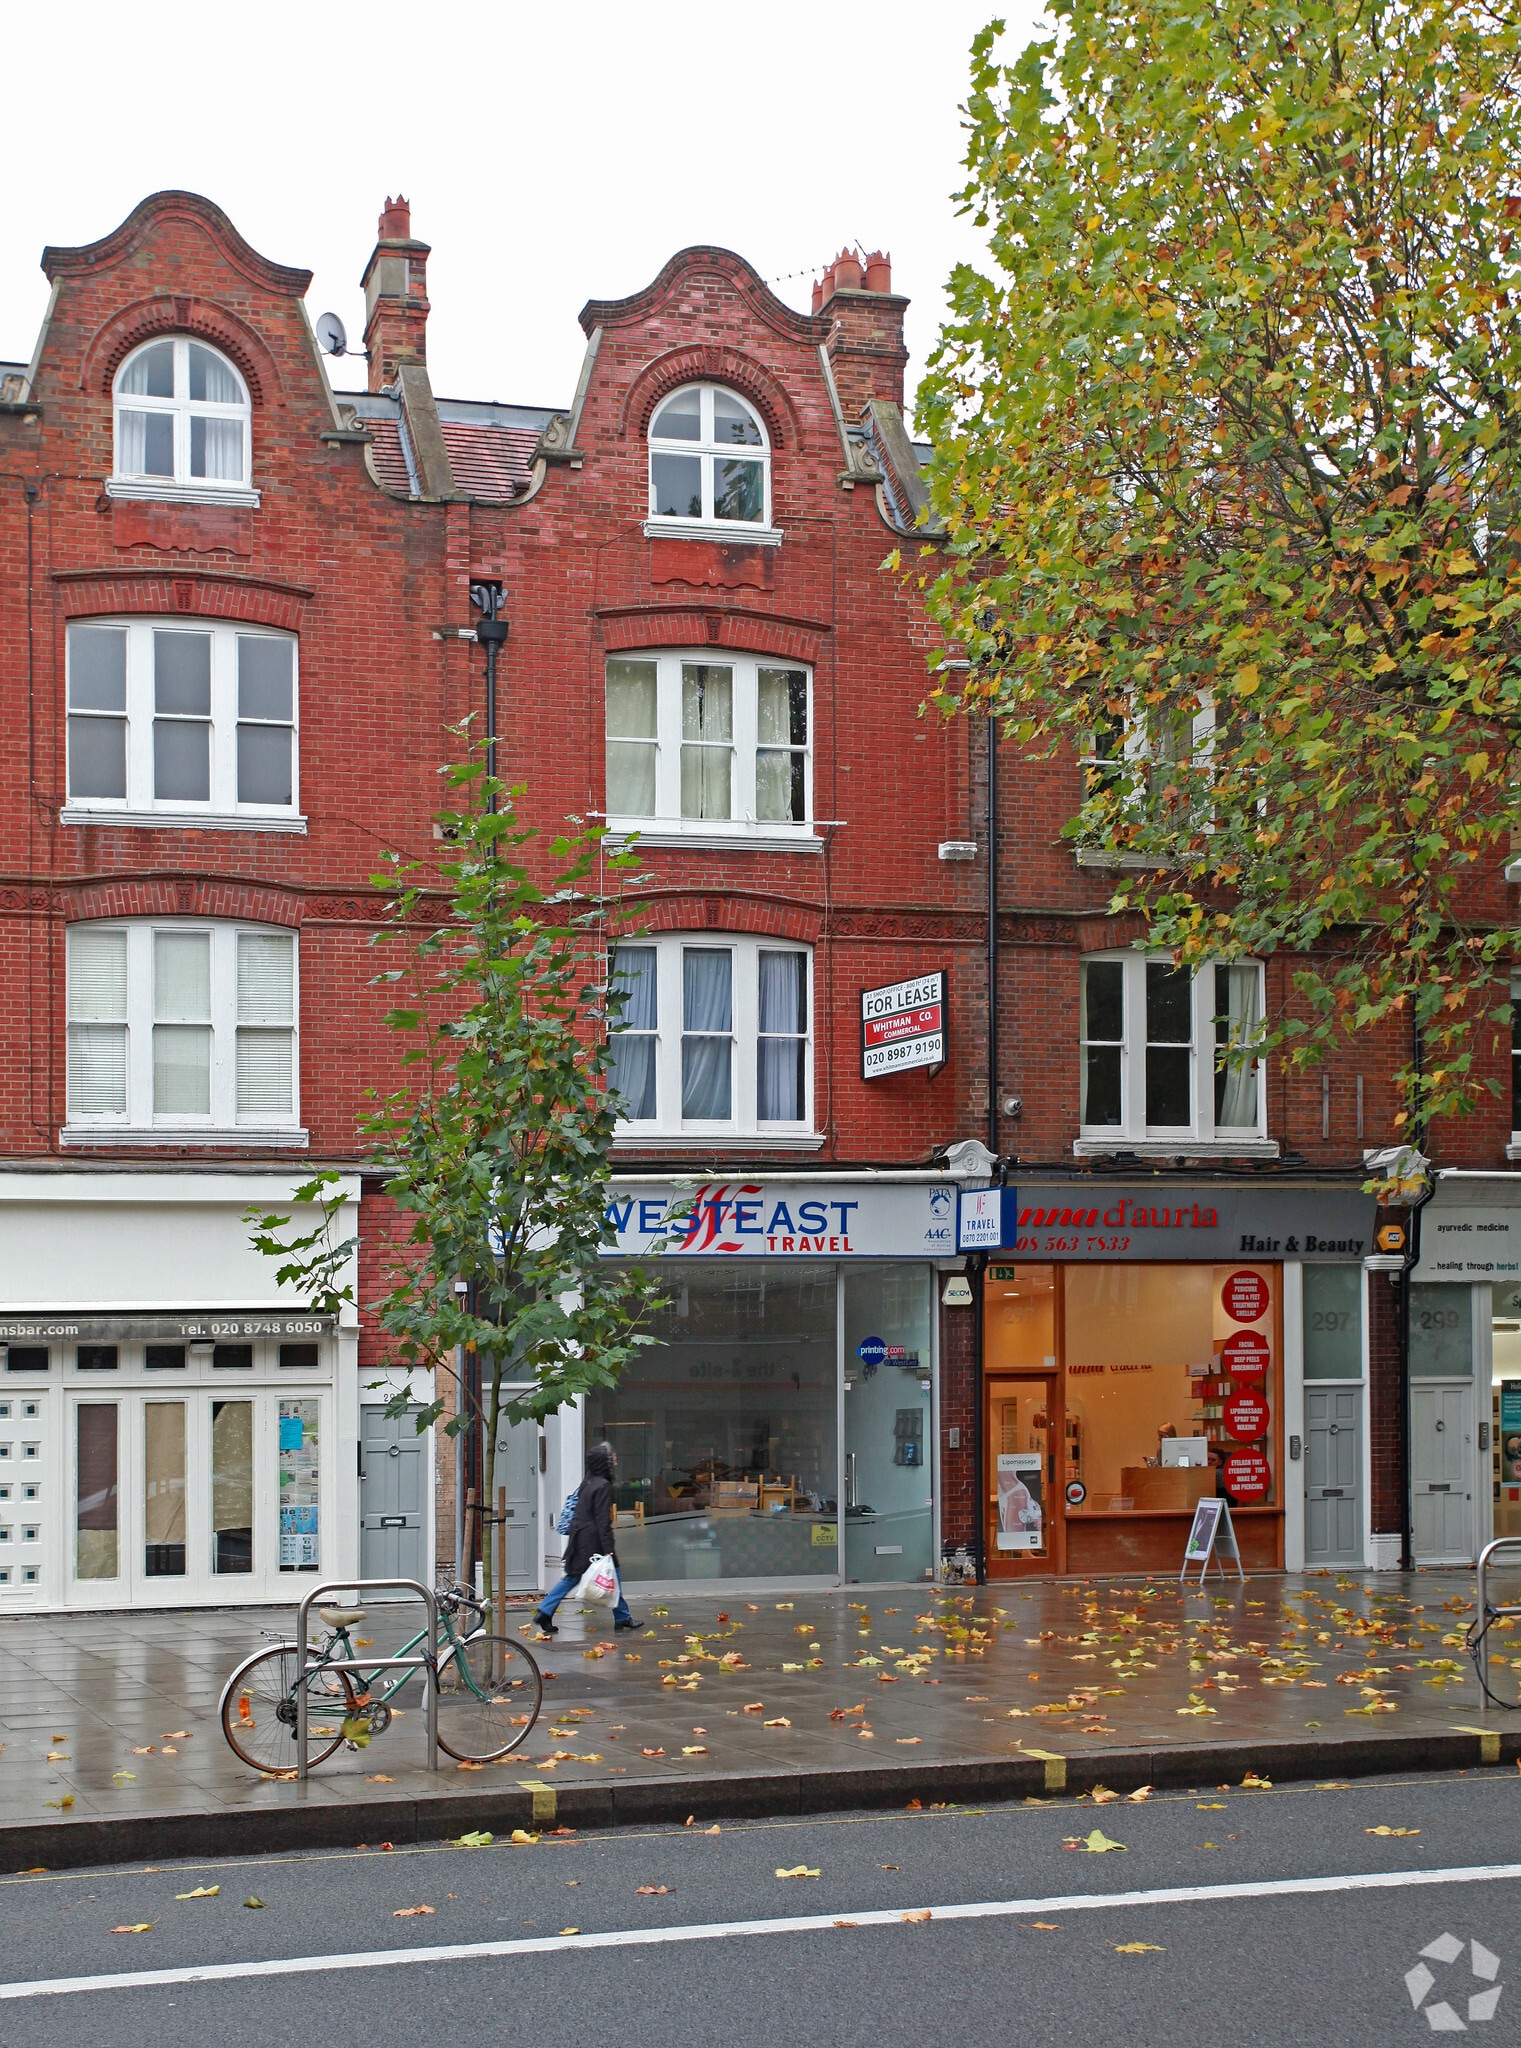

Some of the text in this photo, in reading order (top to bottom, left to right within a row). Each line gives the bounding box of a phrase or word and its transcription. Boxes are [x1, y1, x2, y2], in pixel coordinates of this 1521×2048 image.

[867, 984, 938, 1015] FOR LEASE
[873, 1011, 932, 1033] WHITMAN CO.
[884, 1025, 921, 1039] COMMERCIAL
[866, 1039, 941, 1066] 020 8987 9190
[929, 1188, 952, 1198] PATA
[1016, 1199, 1218, 1227] nna d'auria
[967, 1219, 995, 1230] TRAVEL
[1437, 1223, 1509, 1233] ayurvedic medicine
[767, 1236, 854, 1252] TRAVEL
[963, 1232, 999, 1243] 0870 2201 001
[1044, 1236, 1080, 1251] 563
[1087, 1236, 1131, 1251] 7833
[1240, 1235, 1364, 1255] Hair & Beauty
[1467, 1262, 1494, 1272] through
[1496, 1262, 1519, 1270] herbs!
[948, 1289, 970, 1297] SECOM
[1004, 1306, 1035, 1325] 297
[1311, 1312, 1350, 1331] 297
[1420, 1310, 1459, 1330] 299
[0, 1324, 79, 1335] nsbar.com
[178, 1322, 322, 1335] Tel. 020 8748 6050
[860, 1346, 905, 1356] printing.com
